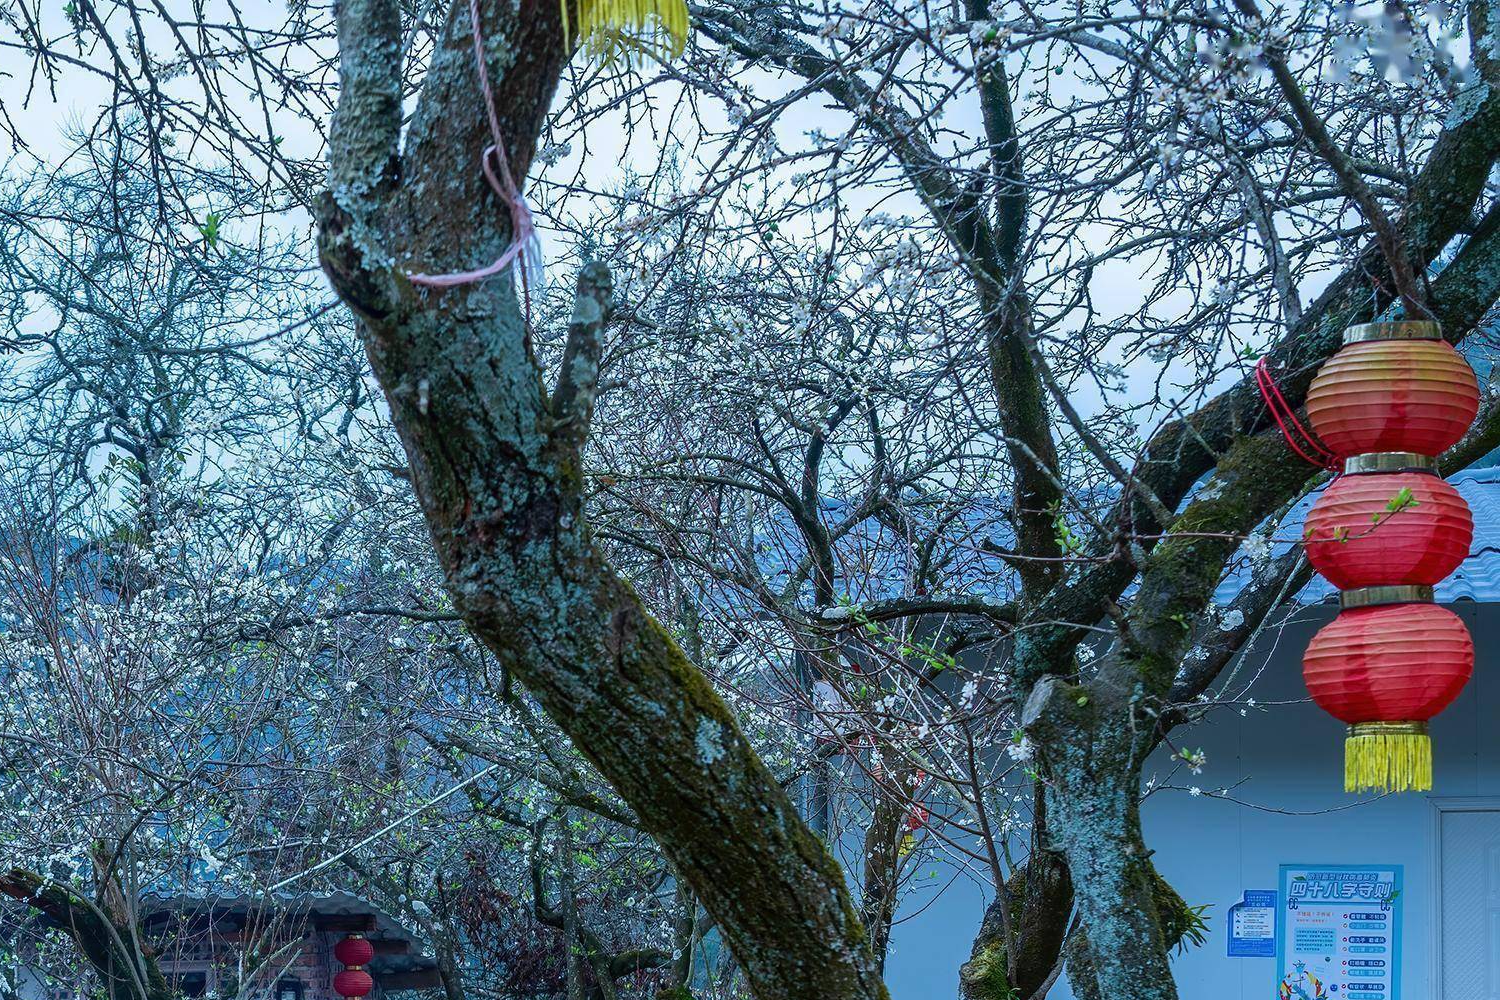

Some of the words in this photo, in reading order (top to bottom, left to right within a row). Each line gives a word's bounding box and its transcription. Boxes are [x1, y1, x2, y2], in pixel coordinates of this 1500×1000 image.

[1290, 881, 1392, 898] 四十八字守则
